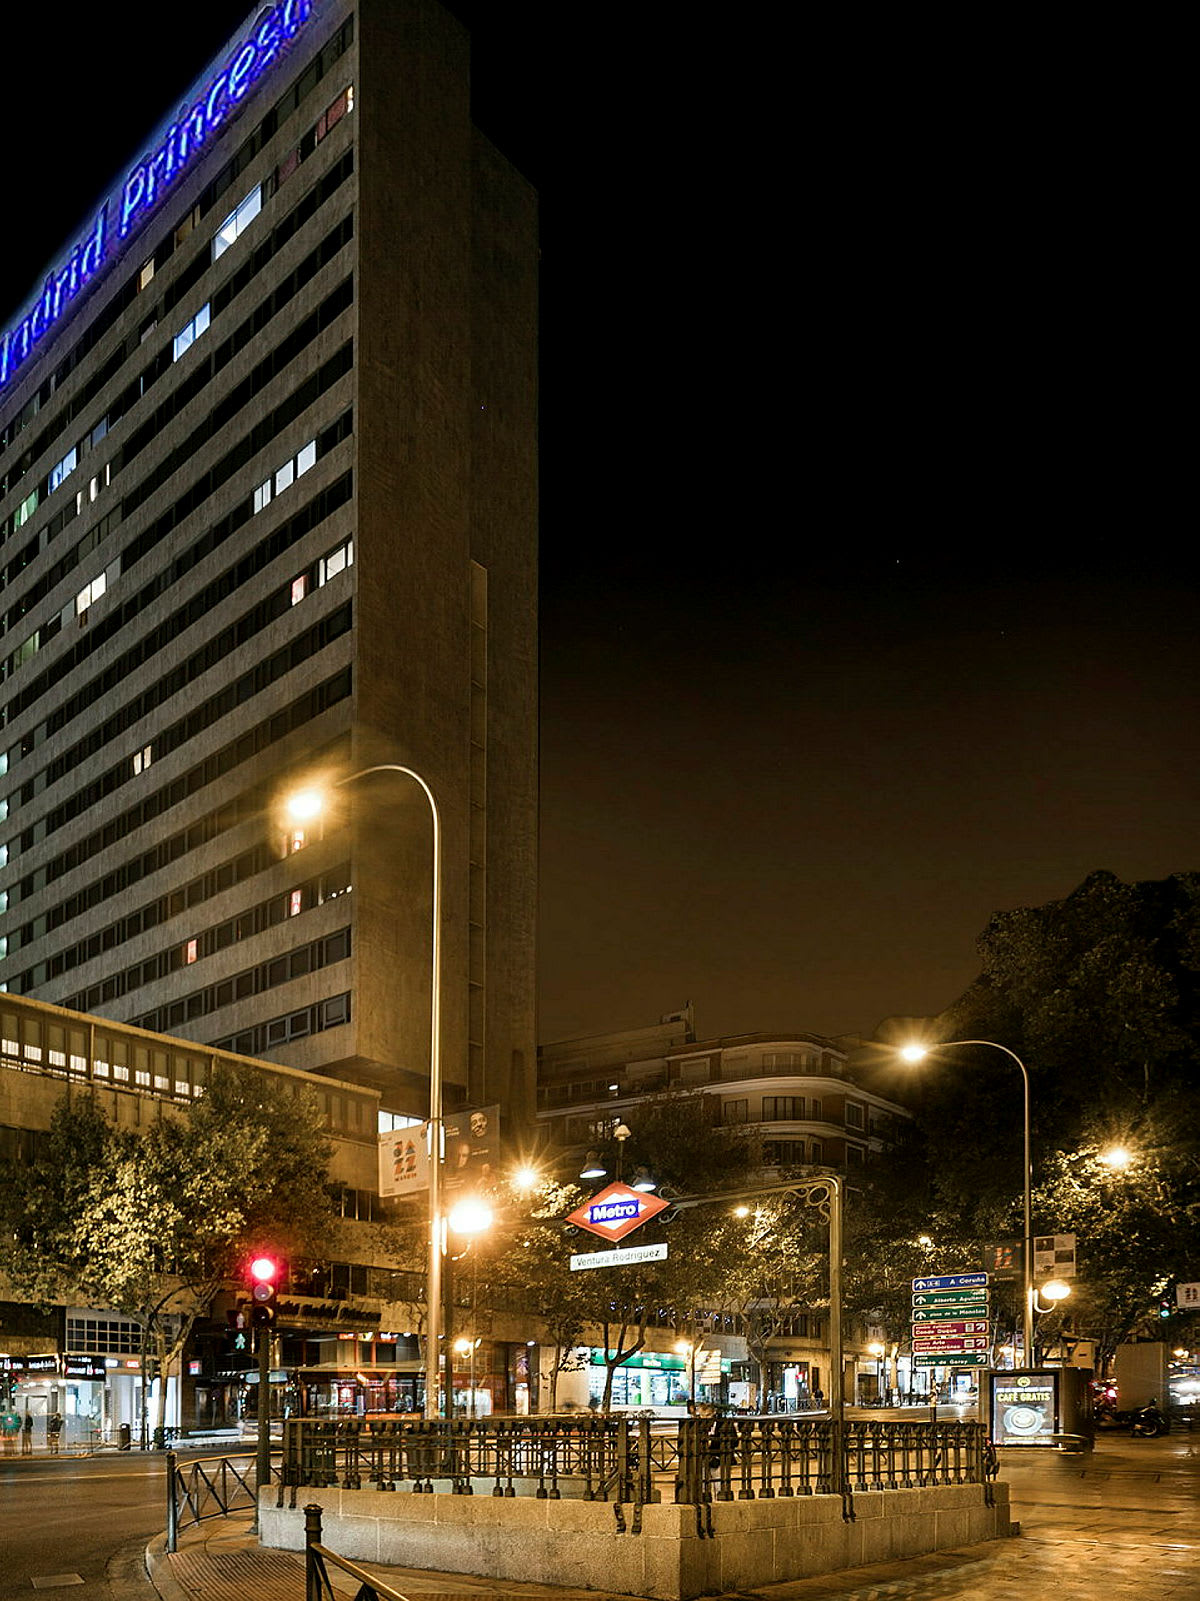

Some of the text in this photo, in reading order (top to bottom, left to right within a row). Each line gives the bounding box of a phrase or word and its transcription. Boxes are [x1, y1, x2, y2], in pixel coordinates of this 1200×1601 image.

[592, 1204, 637, 1221] Metro
[576, 1256, 610, 1267] Ventura
[1020, 1392, 1051, 1401] GRATIS
